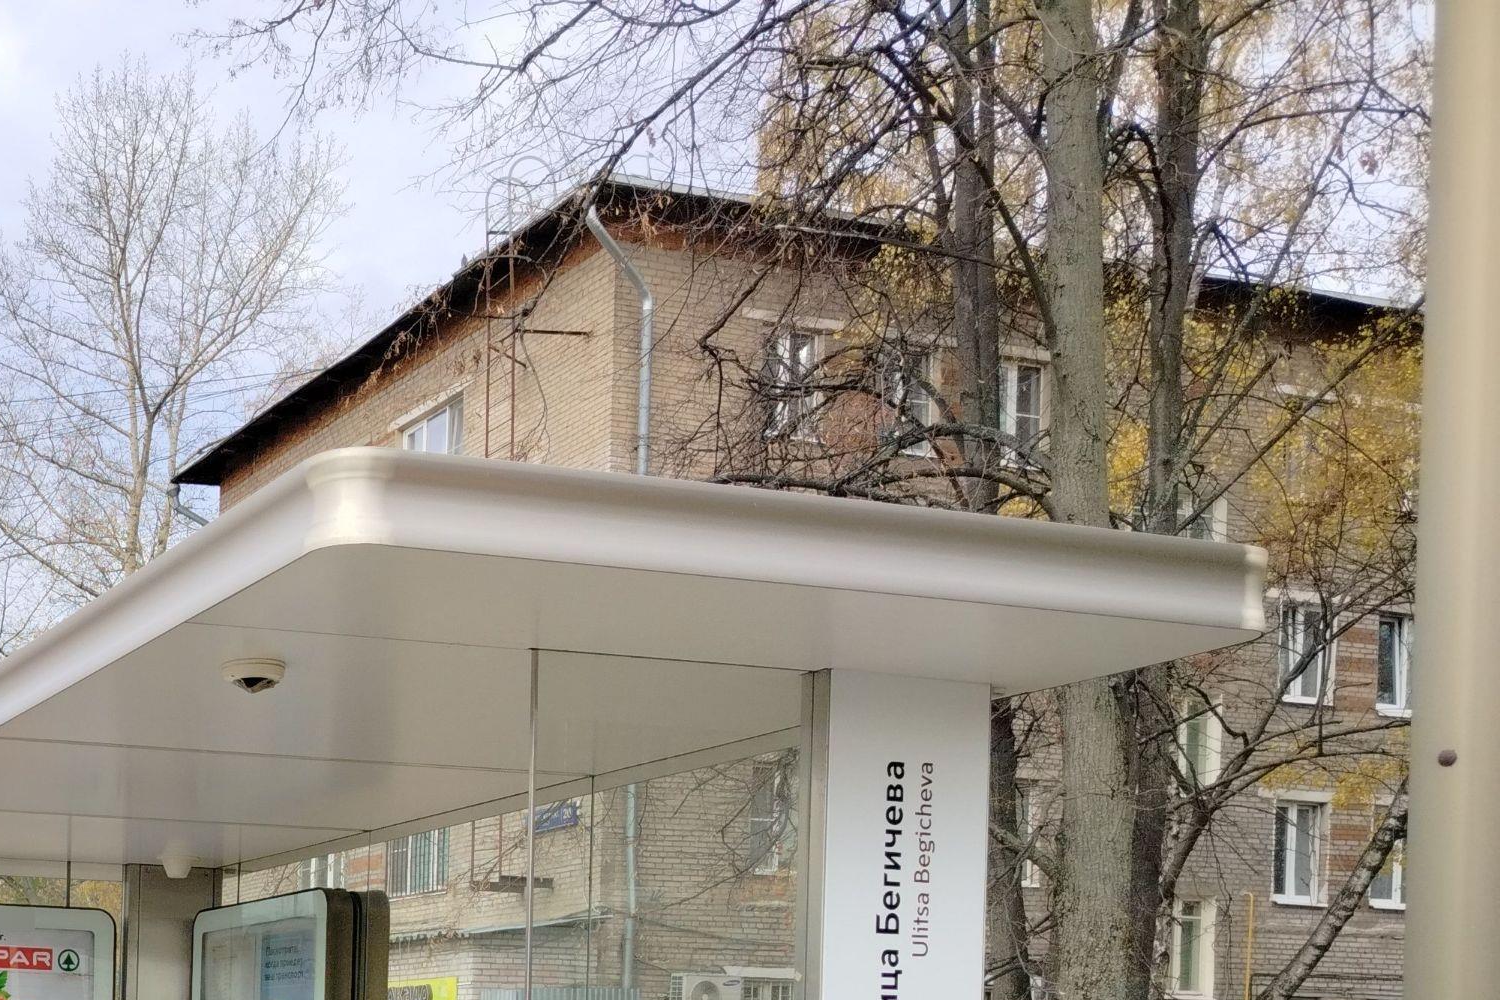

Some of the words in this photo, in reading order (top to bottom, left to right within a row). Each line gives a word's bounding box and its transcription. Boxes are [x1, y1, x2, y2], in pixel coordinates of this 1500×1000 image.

[876, 761, 905, 935] Бегичева
[914, 762, 935, 884] Begicheva
[912, 893, 930, 957] Ulitsa
